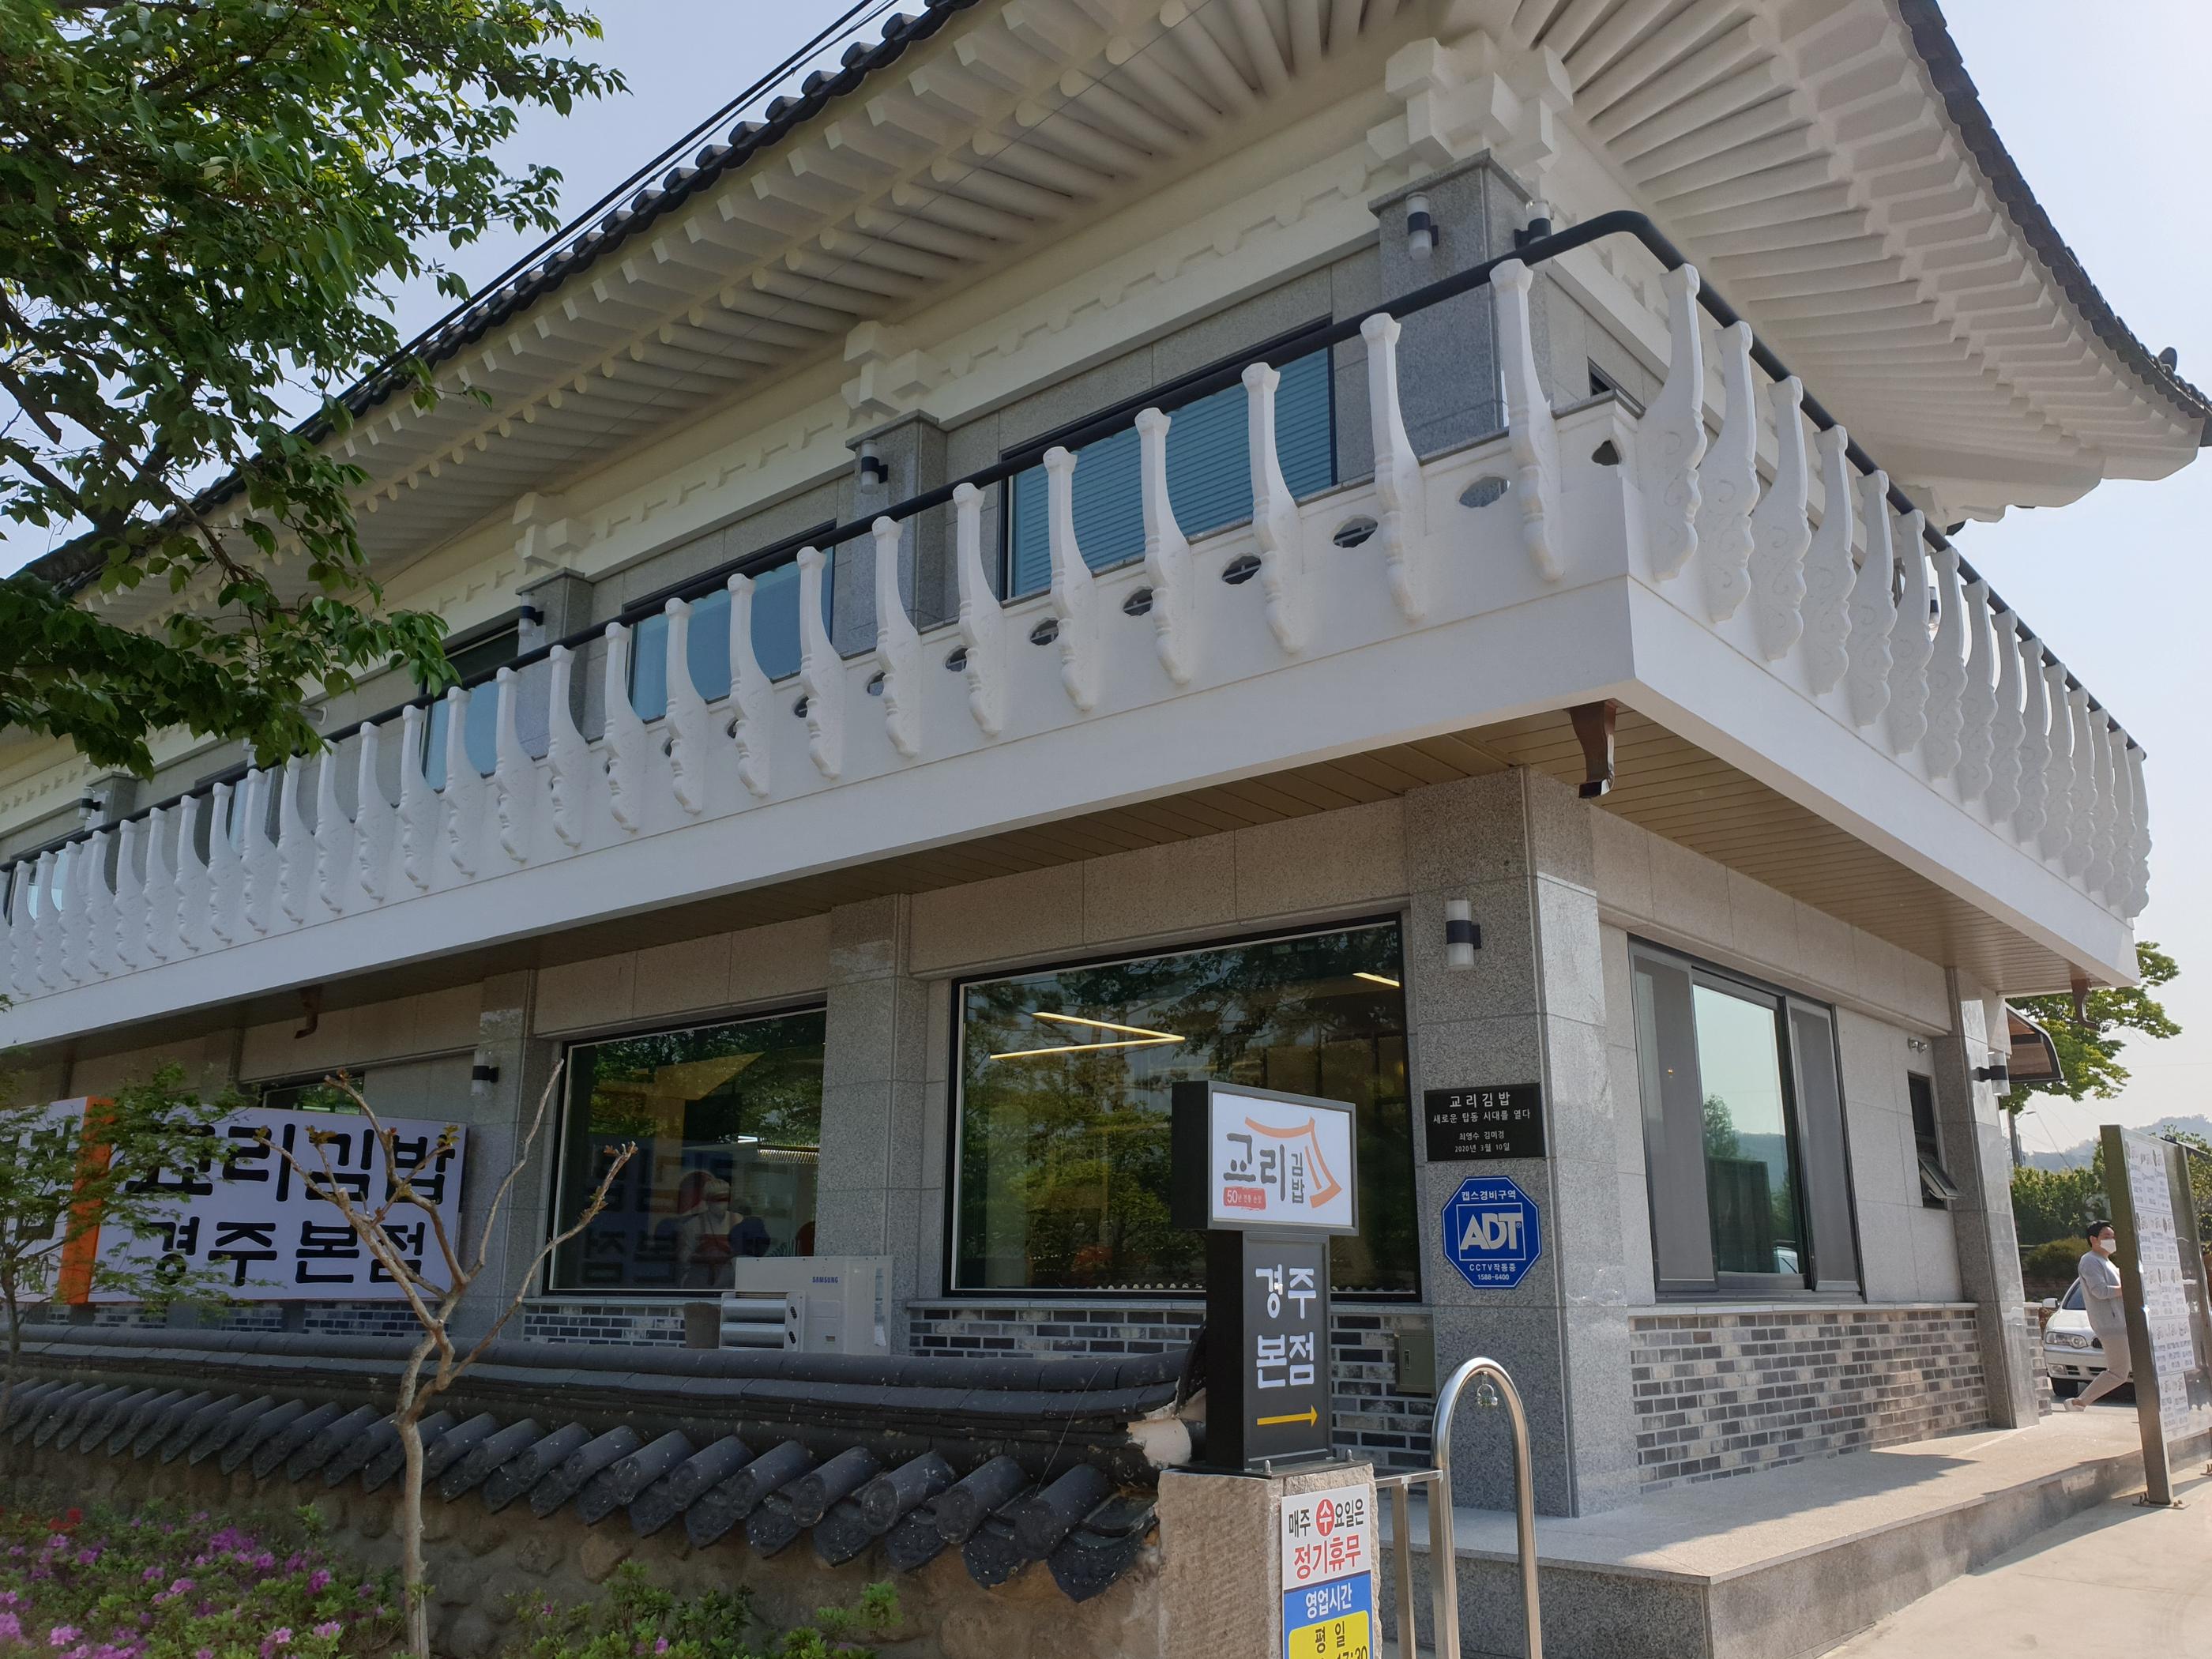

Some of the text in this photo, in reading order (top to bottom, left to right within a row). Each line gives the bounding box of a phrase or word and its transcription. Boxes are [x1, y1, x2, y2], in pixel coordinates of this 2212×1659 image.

[1433, 1108, 1531, 1124] 새로운 탑동 시대를 열다
[1449, 1091, 1510, 1108] 교리김밥
[1454, 1142, 1510, 1153] 2020년 3월 10일
[1462, 1190, 1516, 1201] 캡스경비구역
[1460, 1213, 1522, 1250] ADT
[1255, 1264, 1317, 1319] 경주
[1256, 1331, 1315, 1390] 본점
[1288, 1508, 1311, 1538] 매주
[1294, 1534, 1361, 1580] 정기휴무
[1305, 1582, 1352, 1619] 영업시간
